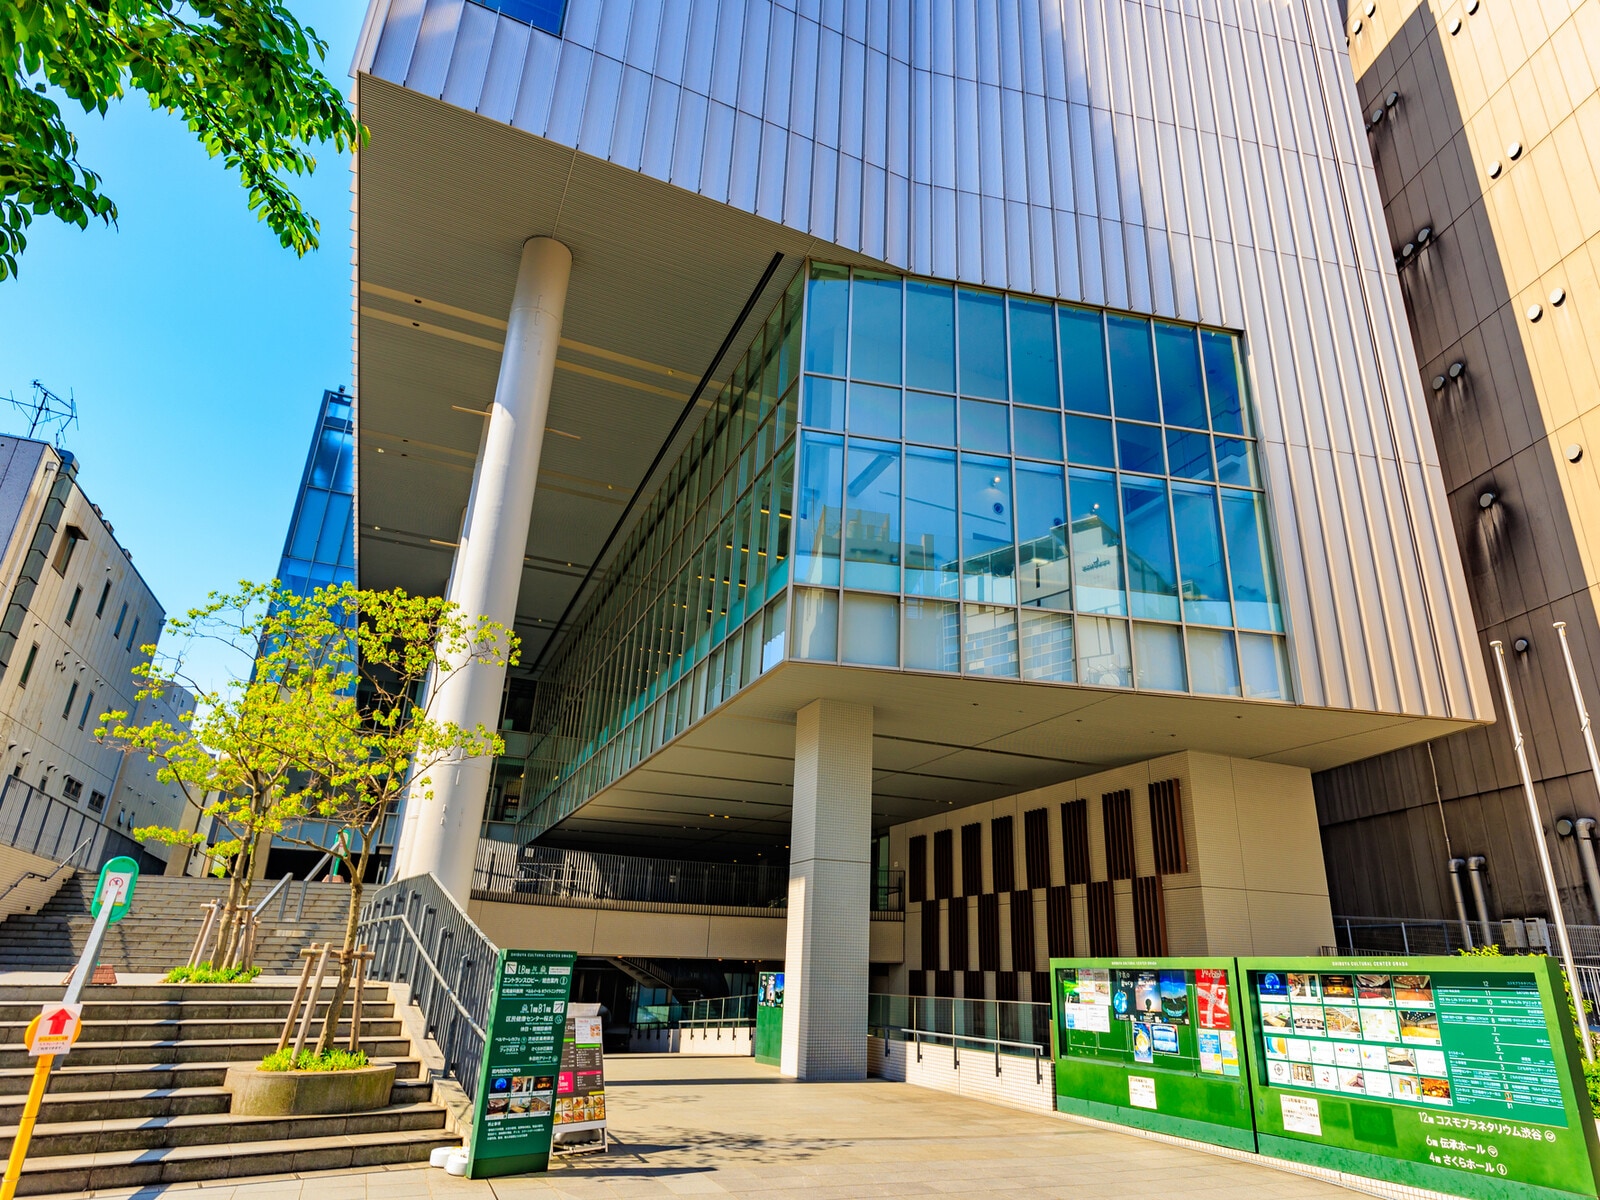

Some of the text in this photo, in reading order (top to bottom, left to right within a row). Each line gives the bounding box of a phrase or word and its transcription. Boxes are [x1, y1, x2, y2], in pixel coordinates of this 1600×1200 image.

[1436, 1115, 1542, 1140] コスモプラネタリウム渋谷
[1440, 1137, 1485, 1155] 伝承ホール
[1443, 1155, 1494, 1173] さくらホール
